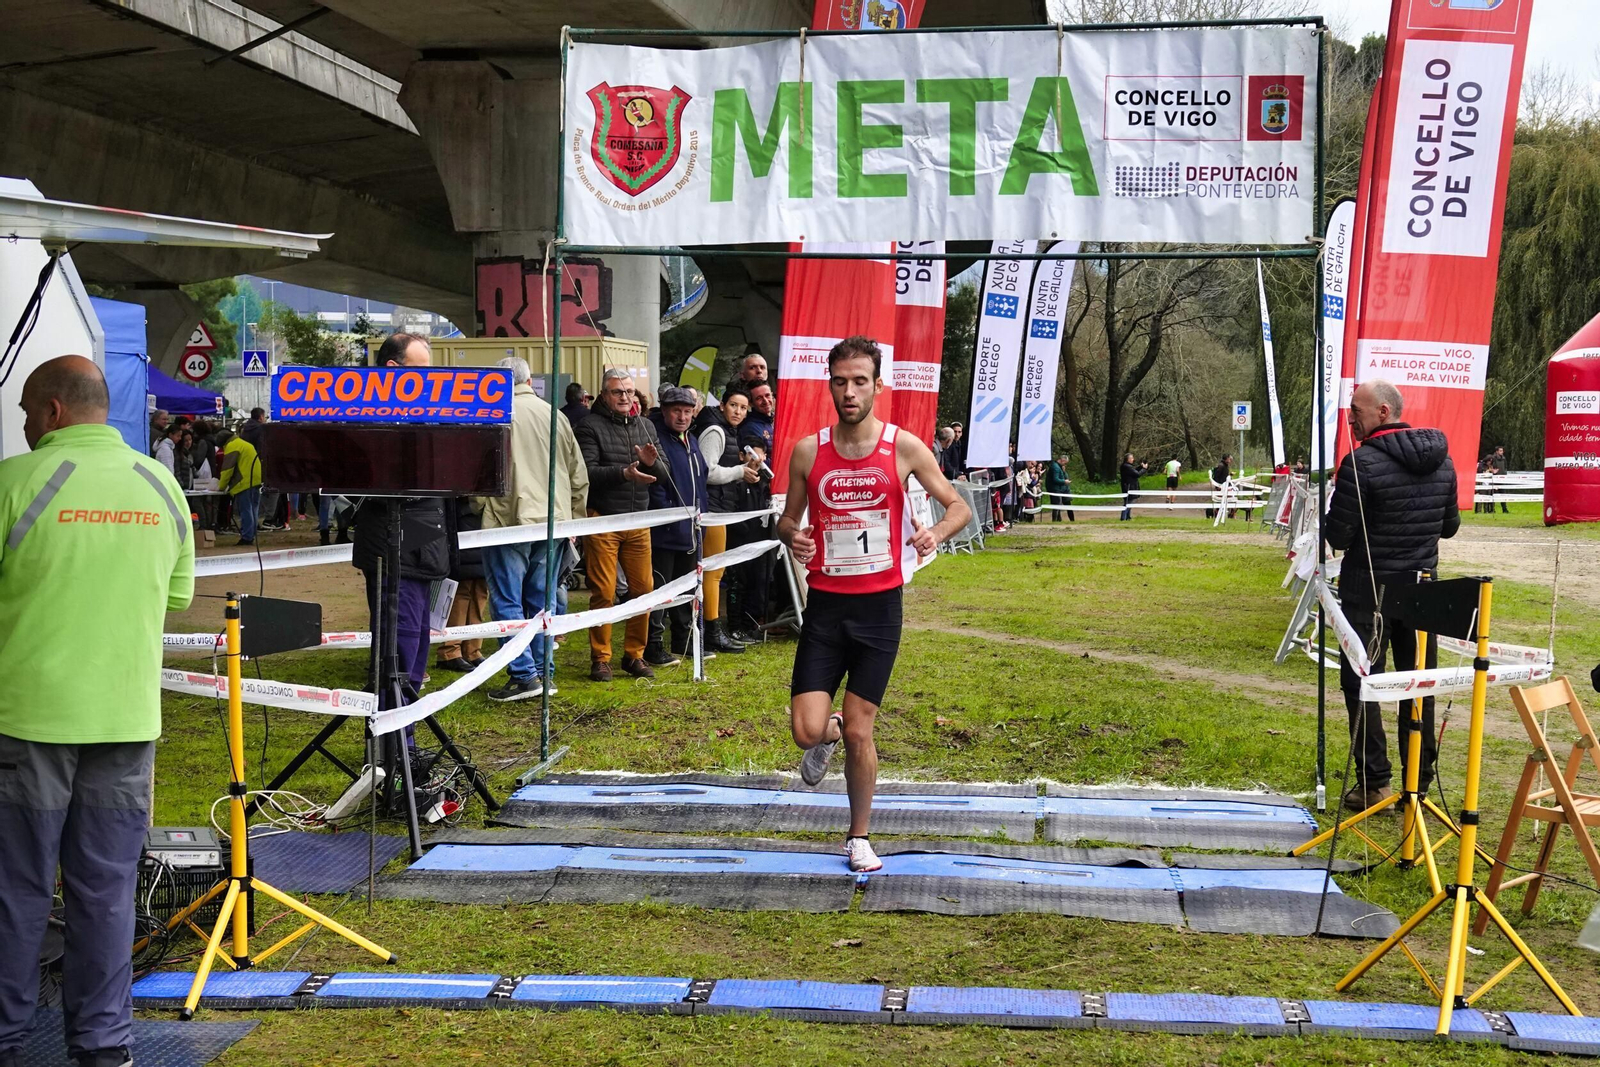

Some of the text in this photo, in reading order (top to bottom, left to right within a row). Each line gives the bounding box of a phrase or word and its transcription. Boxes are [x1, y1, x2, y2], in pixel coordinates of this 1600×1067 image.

[1115, 90, 1231, 106] CONCELLO
[1128, 110, 1217, 126] DE VIGO
[709, 76, 1100, 202] META
[1407, 58, 1450, 238] CONCELLO
[1442, 81, 1483, 218] DE VIGO
[574, 128, 698, 211] Placa de Bronce Real Orden del Mérito Deportivo 2015
[1186, 162, 1298, 182] DEPUTACIÓN
[1185, 184, 1299, 199] PONTEVEDRA
[992, 246, 1009, 289] XUNA
[1325, 246, 1335, 290] XUNTA
[1334, 223, 1347, 293] DE GALICIA
[1005, 276, 1018, 292] DE
[1047, 260, 1065, 317] DE GALICIA
[1036, 280, 1049, 316] XUNTA
[188, 361, 206, 371] 40
[978, 337, 991, 390] DEPORTE
[988, 344, 1001, 391] GALEGO
[1370, 359, 1471, 372] A MELLOR CIDADE
[278, 371, 506, 404] CRONOTEC
[1025, 355, 1036, 398] DEPORTE
[1034, 360, 1044, 399] GALEGO
[1407, 373, 1470, 384] PARA VIVIR
[280, 407, 504, 418] WWW.CRONOTEC.ES
[1561, 423, 1589, 431] Vivimos
[1583, 461, 1594, 469] de
[832, 477, 876, 487] ATLETISMO
[832, 491, 873, 501] SANTIAGO
[58, 510, 160, 525] CRONOTEC
[857, 530, 868, 554] 1
